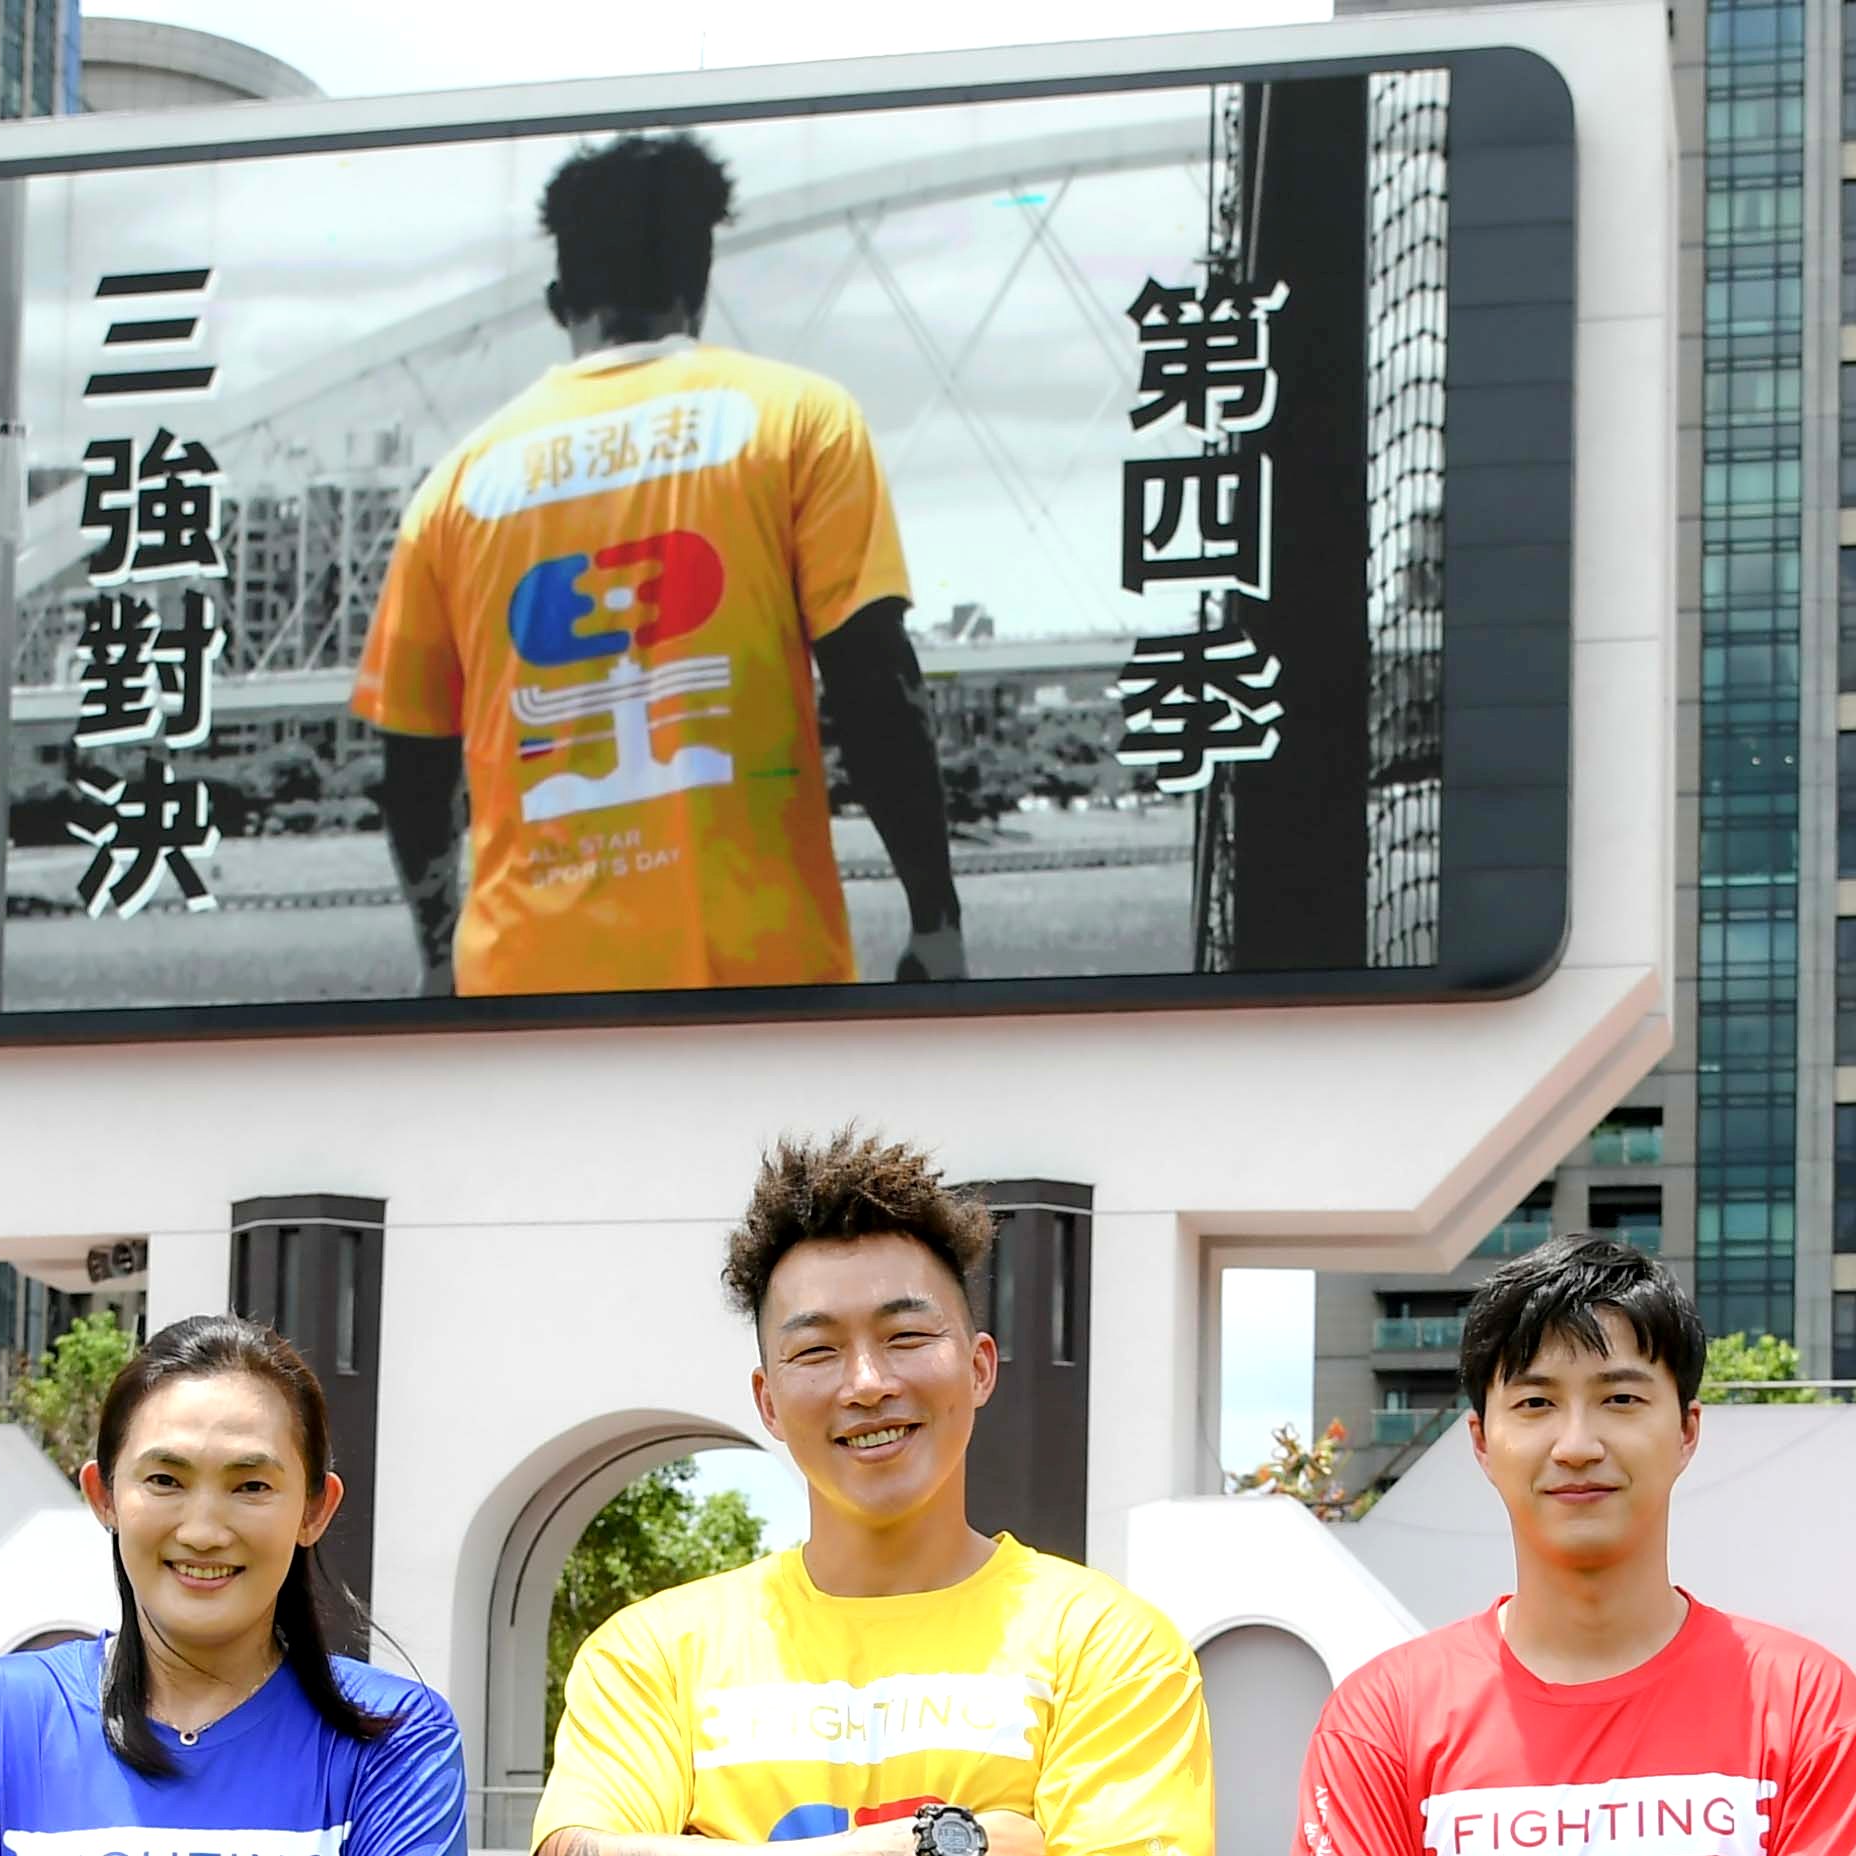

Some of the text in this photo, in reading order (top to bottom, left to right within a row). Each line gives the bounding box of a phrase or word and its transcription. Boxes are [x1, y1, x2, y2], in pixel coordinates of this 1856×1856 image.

[66, 267, 228, 920] 三強對決
[1115, 276, 1290, 794] 第四季
[1453, 1797, 1735, 1855] FIGHTING
